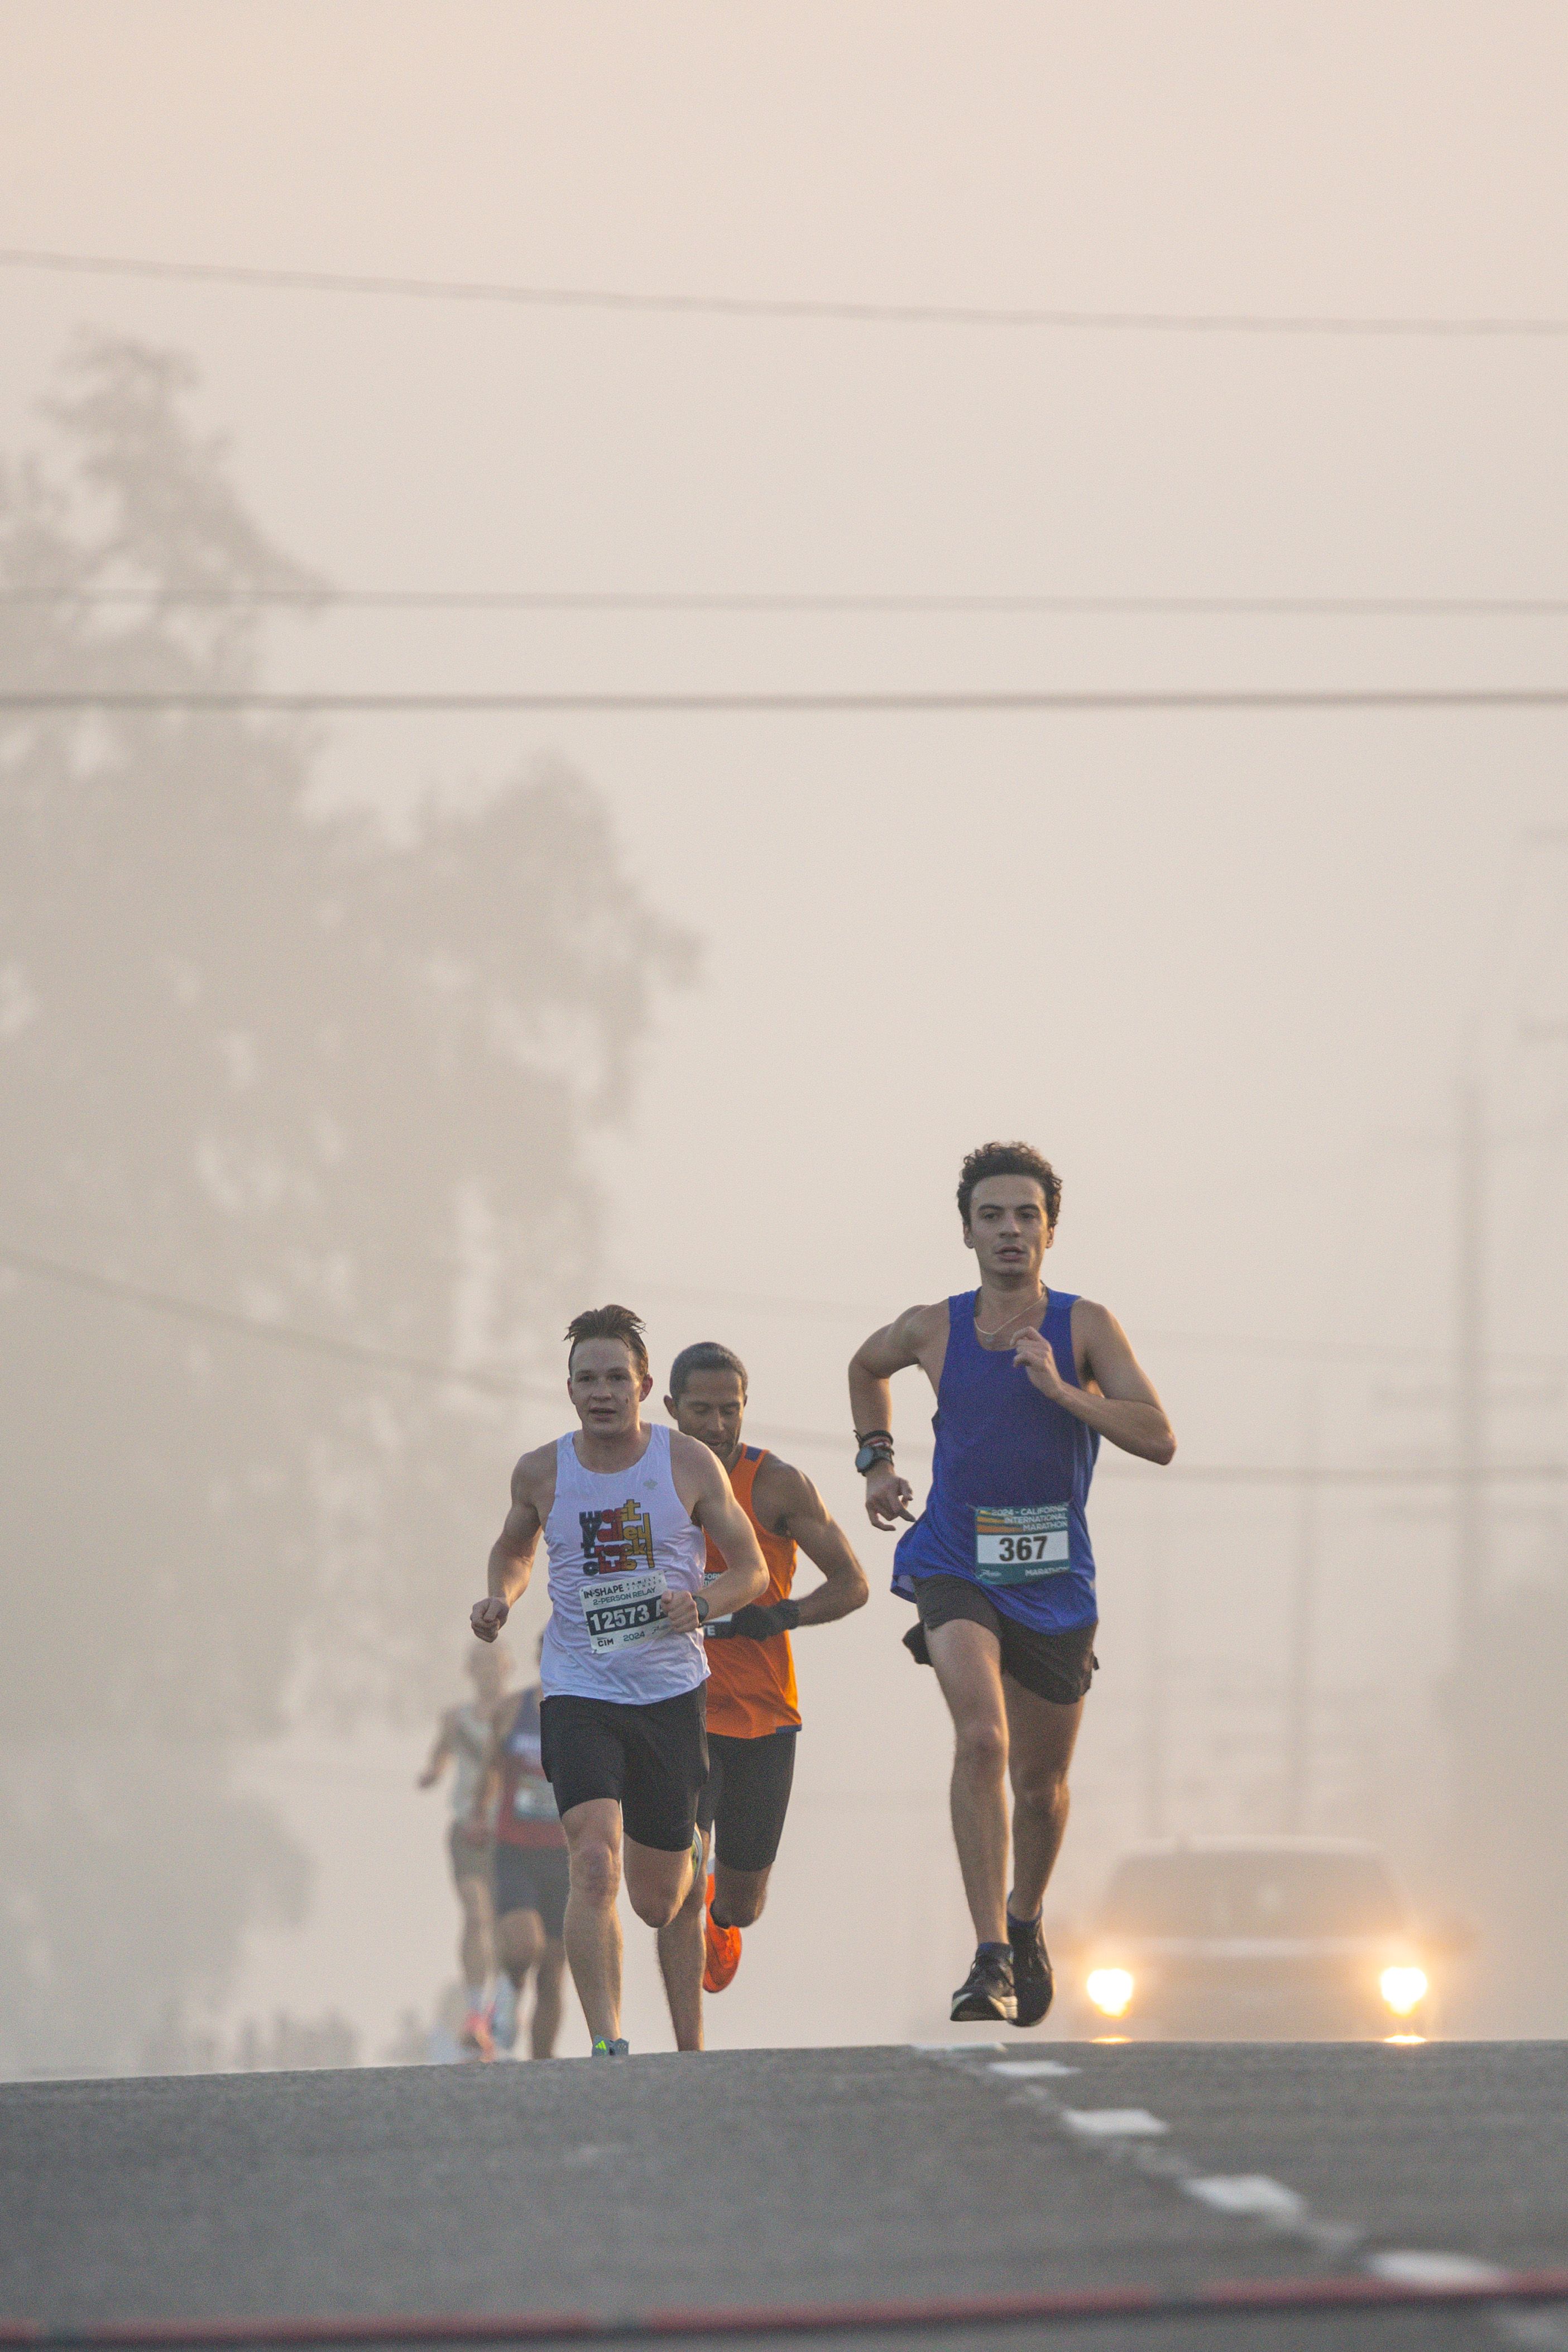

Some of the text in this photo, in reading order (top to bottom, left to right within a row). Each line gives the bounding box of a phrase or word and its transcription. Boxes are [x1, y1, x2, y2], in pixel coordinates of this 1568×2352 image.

[1004, 1513, 1067, 1524] INTERNATIONAL
[1020, 1506, 1067, 1516] CALIFORNIA
[1023, 1521, 1068, 1532] MARATHON
[999, 1535, 1048, 1561] 367
[593, 1587, 656, 1606] 2-PERSON RELAY
[590, 1604, 650, 1631] 12573
[597, 1631, 645, 1647] CIM 2024
